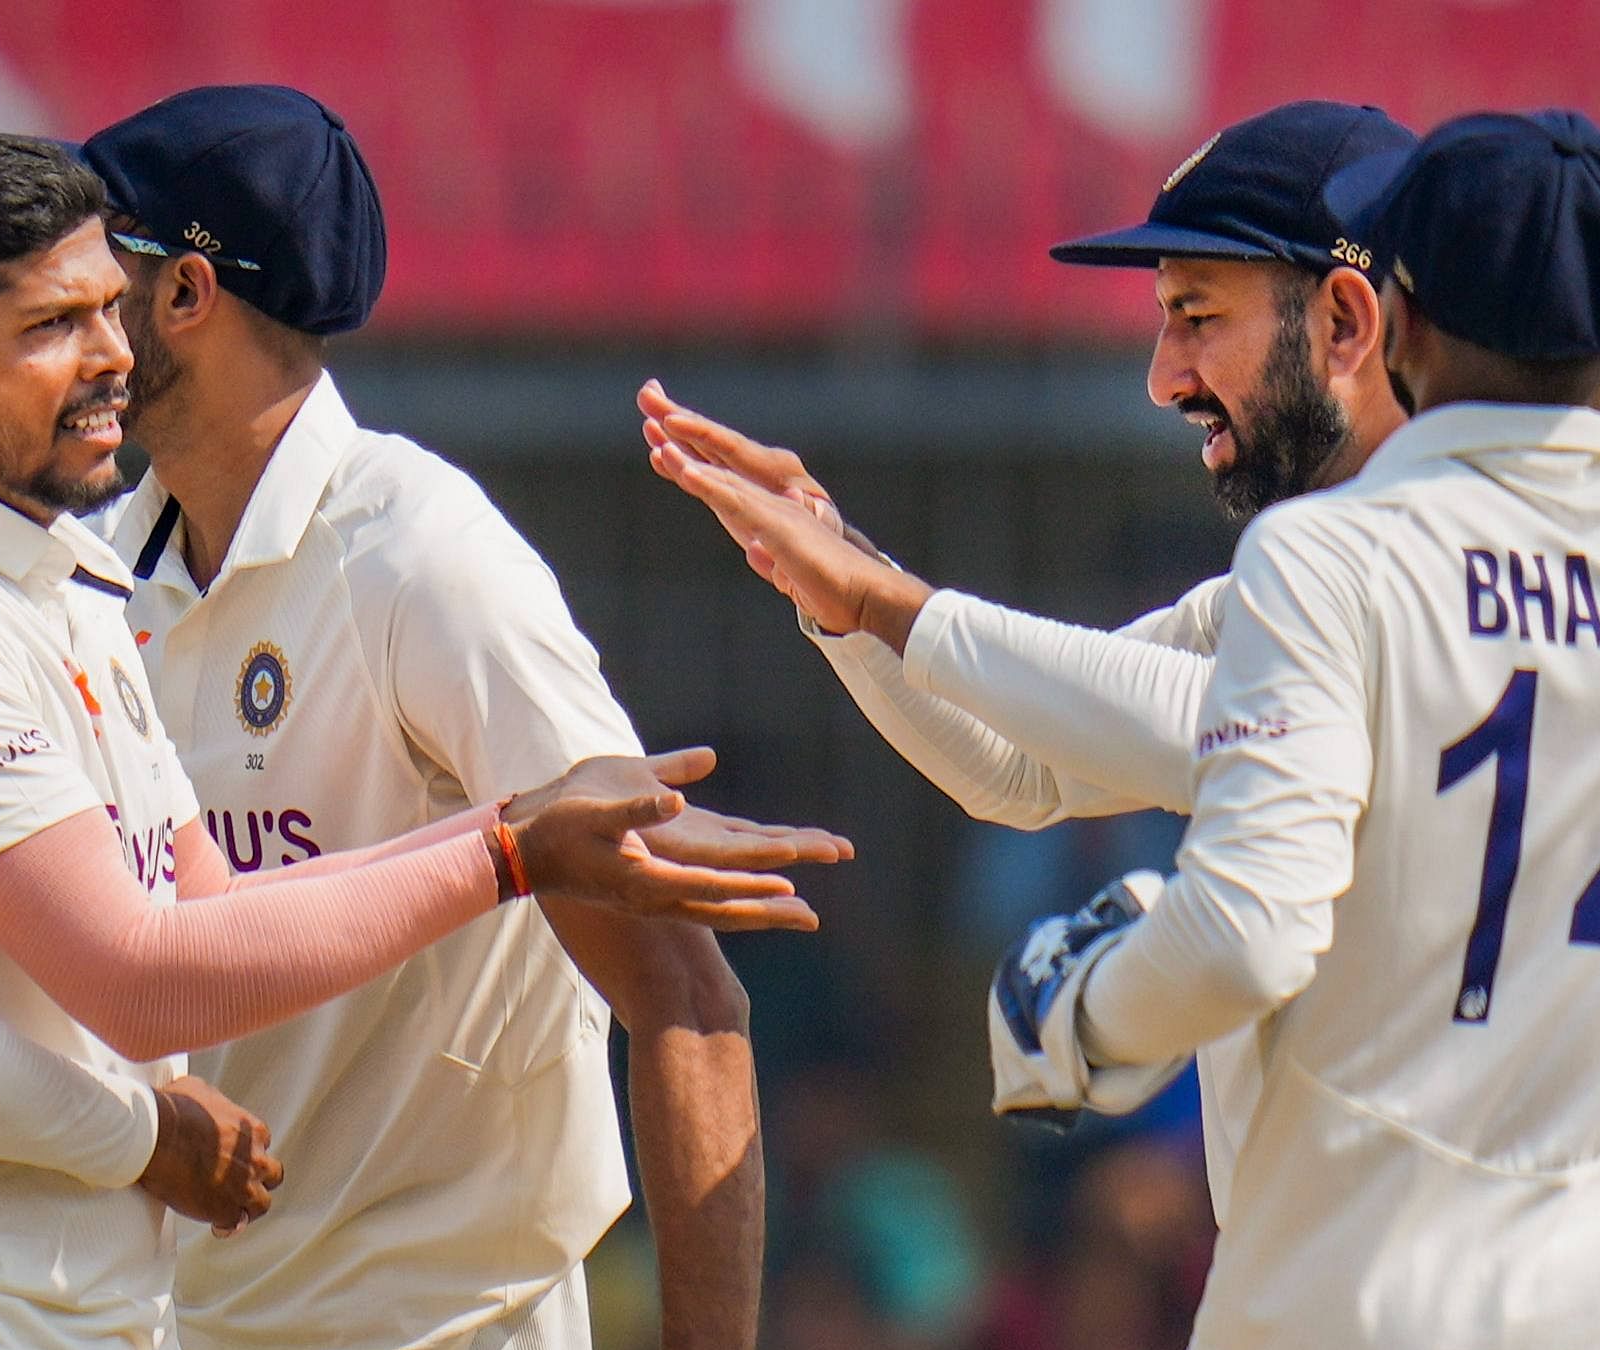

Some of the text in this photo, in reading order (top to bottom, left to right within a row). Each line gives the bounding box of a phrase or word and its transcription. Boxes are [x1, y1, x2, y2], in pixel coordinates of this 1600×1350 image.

[183, 221, 222, 255] 302
[1330, 237, 1373, 270] 266
[245, 753, 265, 770] 302
